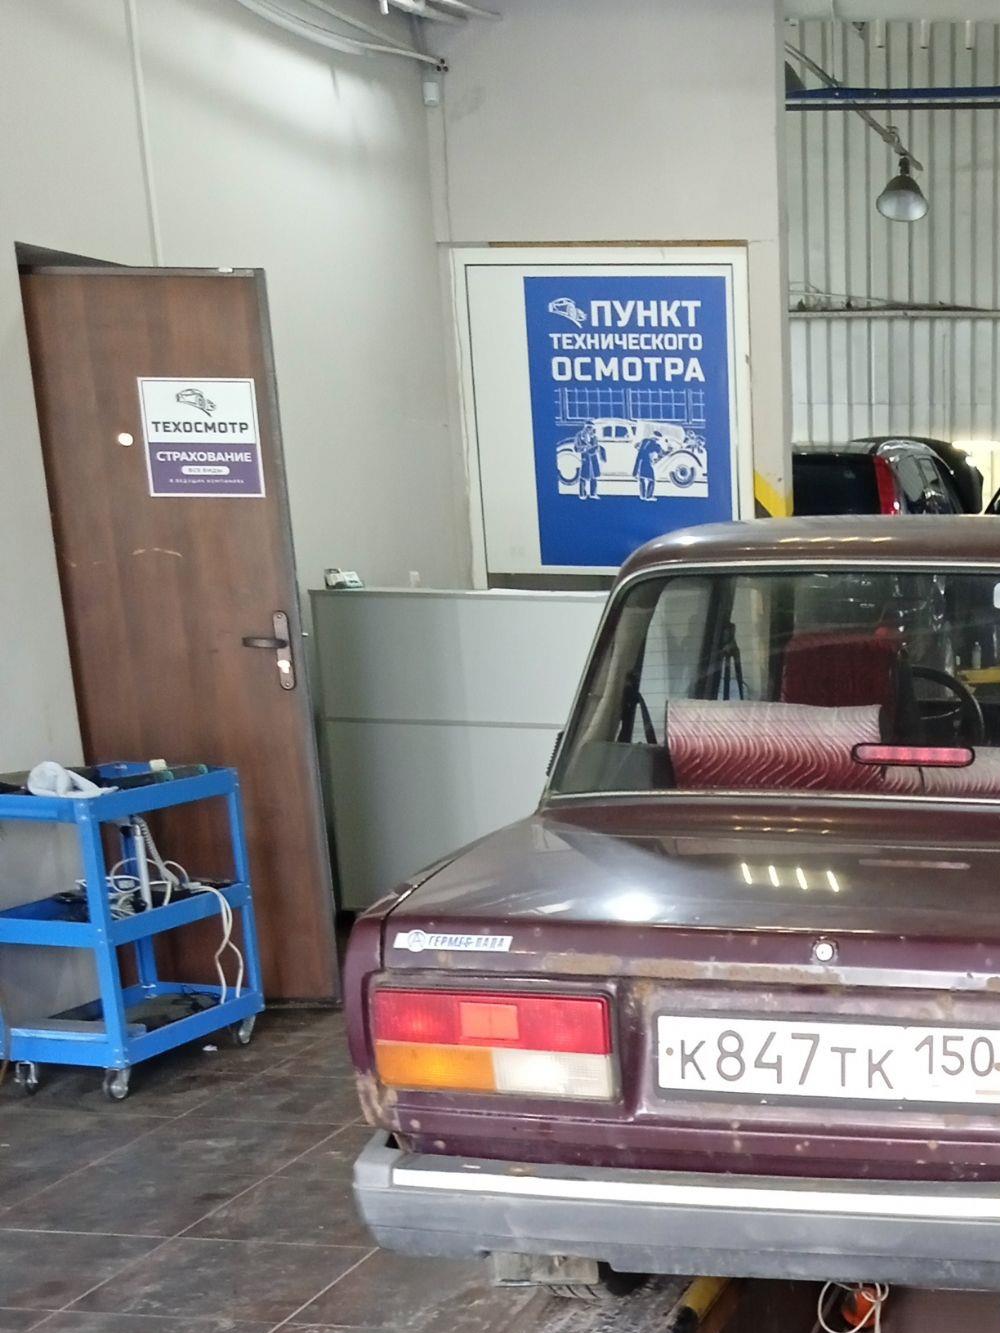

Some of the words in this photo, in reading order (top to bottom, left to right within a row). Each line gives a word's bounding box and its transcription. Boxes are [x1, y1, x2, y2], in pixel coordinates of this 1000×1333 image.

[590, 300, 702, 327] ПУНКТ
[549, 333, 703, 350] ТЕХНИЧЕСКОГО
[552, 356, 706, 382] ОСМОТРА
[151, 421, 249, 434] ТЕХОСМОТР
[156, 451, 253, 463] СТРАХОВАНИЕ
[914, 1035, 996, 1077] 150
